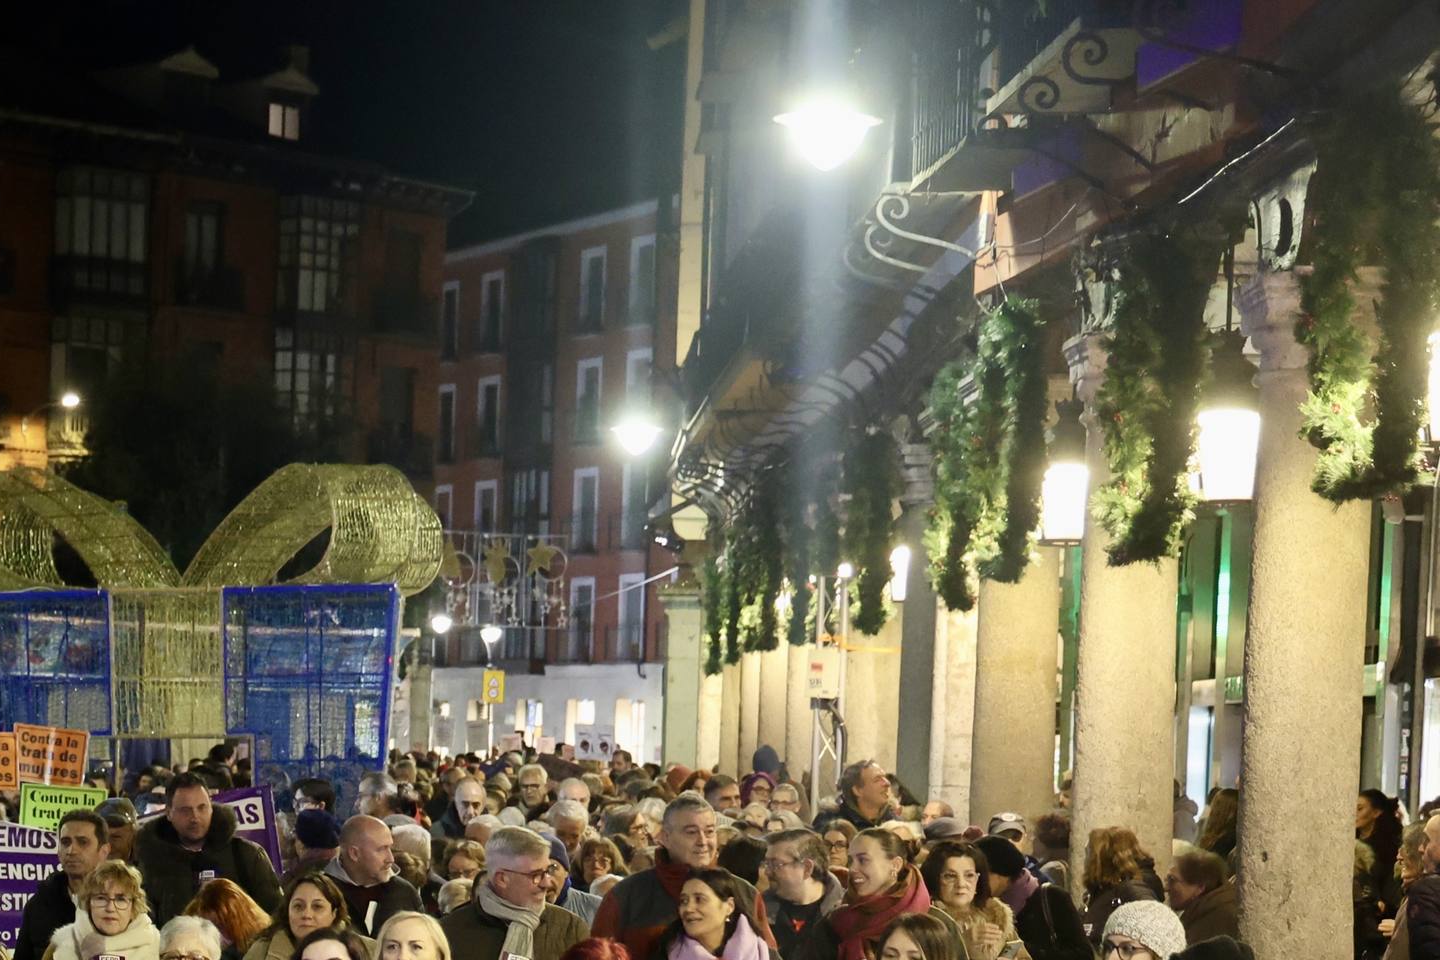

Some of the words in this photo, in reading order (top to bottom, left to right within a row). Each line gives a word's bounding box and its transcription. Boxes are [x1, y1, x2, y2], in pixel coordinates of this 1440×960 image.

[21, 731, 62, 746] Conta
[66, 736, 78, 748] la
[59, 750, 77, 763] de
[30, 790, 79, 805] Contra
[83, 793, 96, 806] la
[32, 806, 66, 819] trat
